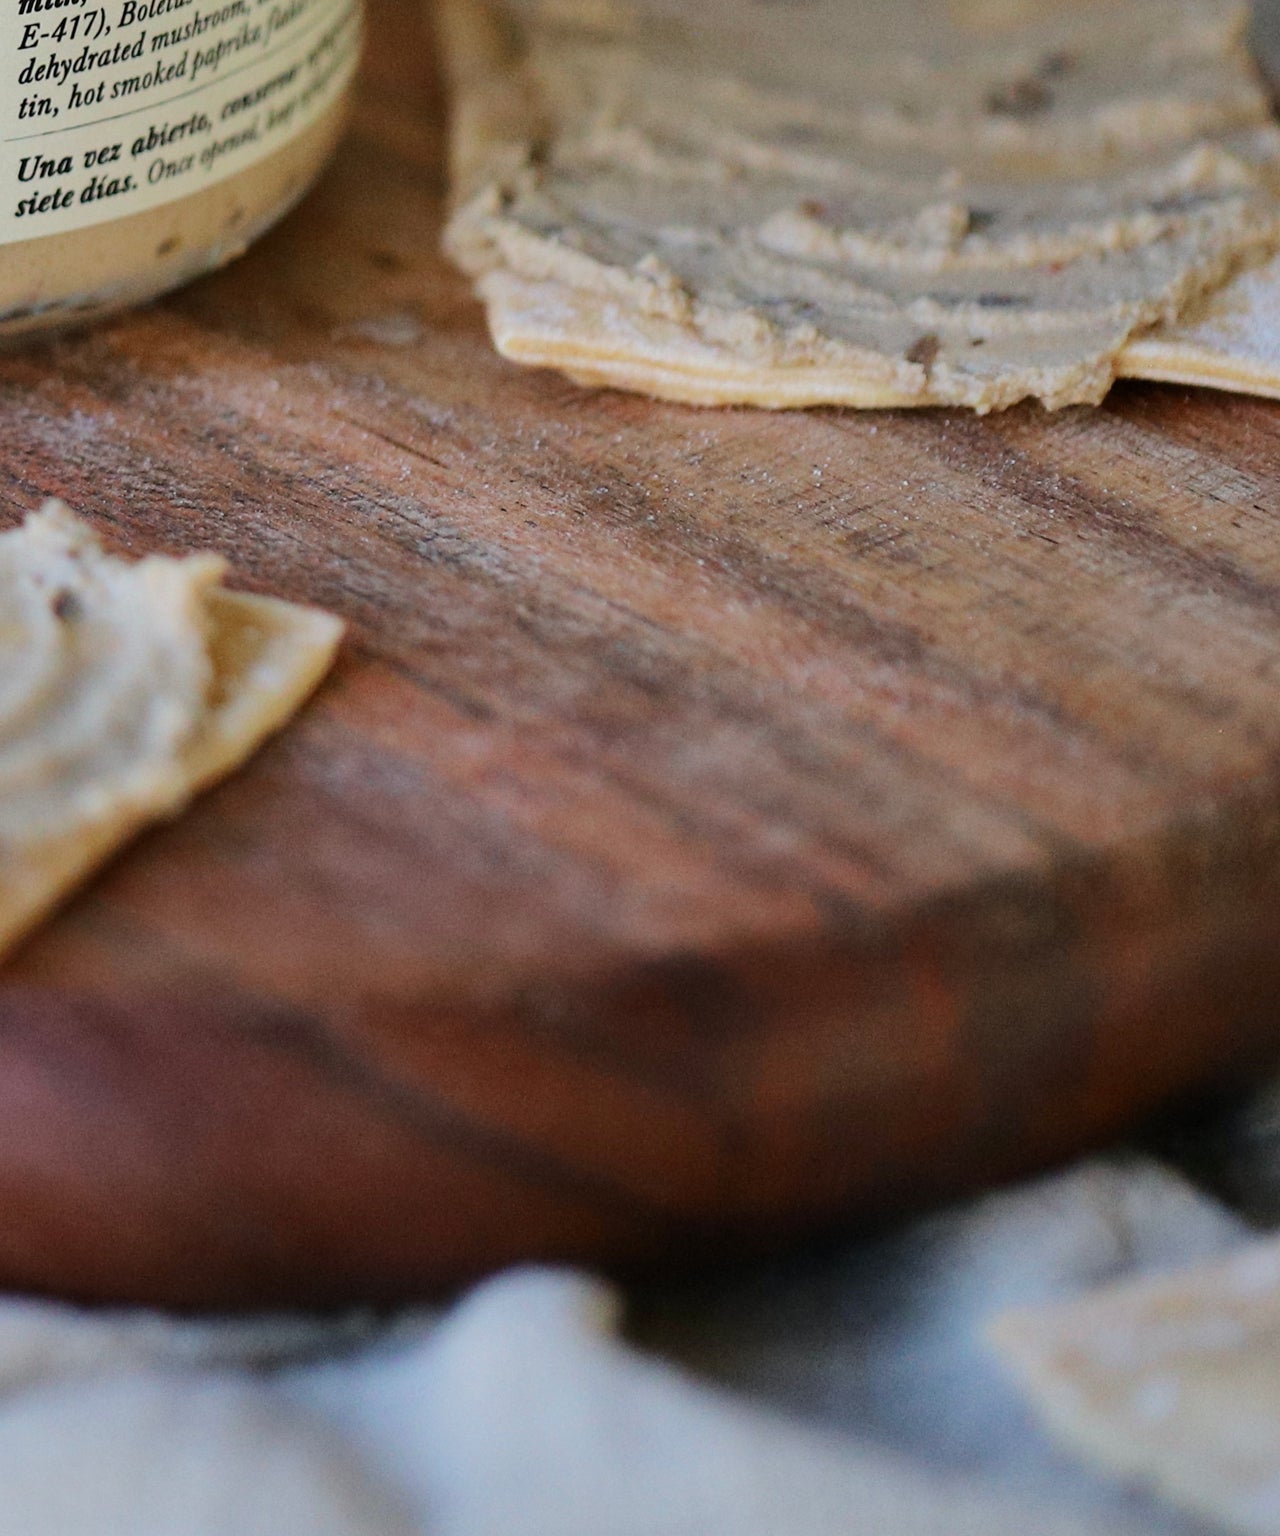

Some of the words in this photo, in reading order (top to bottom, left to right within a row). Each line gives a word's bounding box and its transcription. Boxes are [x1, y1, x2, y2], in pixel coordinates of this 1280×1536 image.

[18, 8, 112, 51] E-417),
[18, 31, 145, 87] dehydrated
[17, 94, 60, 121] tin,
[67, 80, 105, 111] hot
[109, 59, 189, 100] smoked
[190, 21, 262, 81] paprika
[17, 153, 74, 184] Una
[83, 144, 122, 170] vez
[130, 111, 214, 162] abierto,
[15, 187, 76, 219] siete
[80, 173, 139, 205] días.
[147, 154, 196, 186] Once
